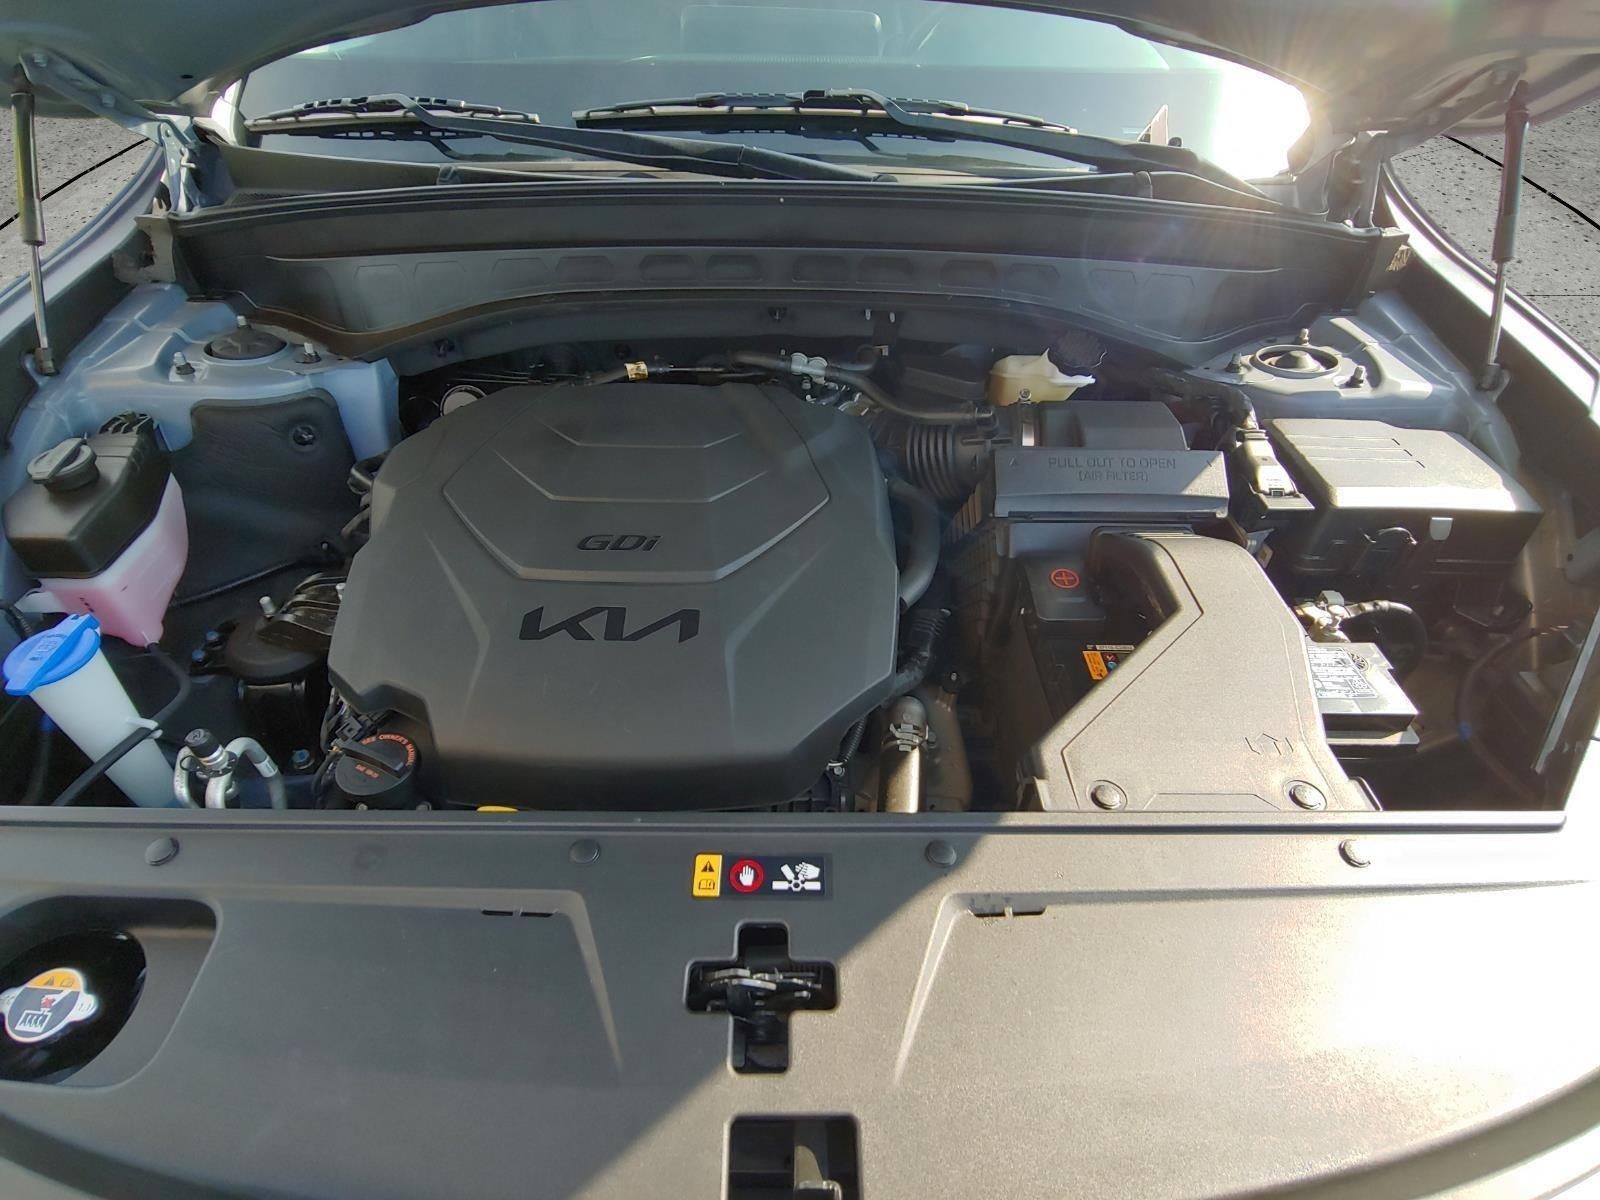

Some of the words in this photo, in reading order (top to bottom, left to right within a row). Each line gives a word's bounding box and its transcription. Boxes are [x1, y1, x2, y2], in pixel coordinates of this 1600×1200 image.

[1048, 456, 1083, 469] PULL
[1087, 456, 1113, 469] OUT
[1120, 456, 1136, 469] TO
[1140, 457, 1176, 470] OPEN
[577, 534, 662, 551] GDi
[519, 606, 700, 643] KIA
